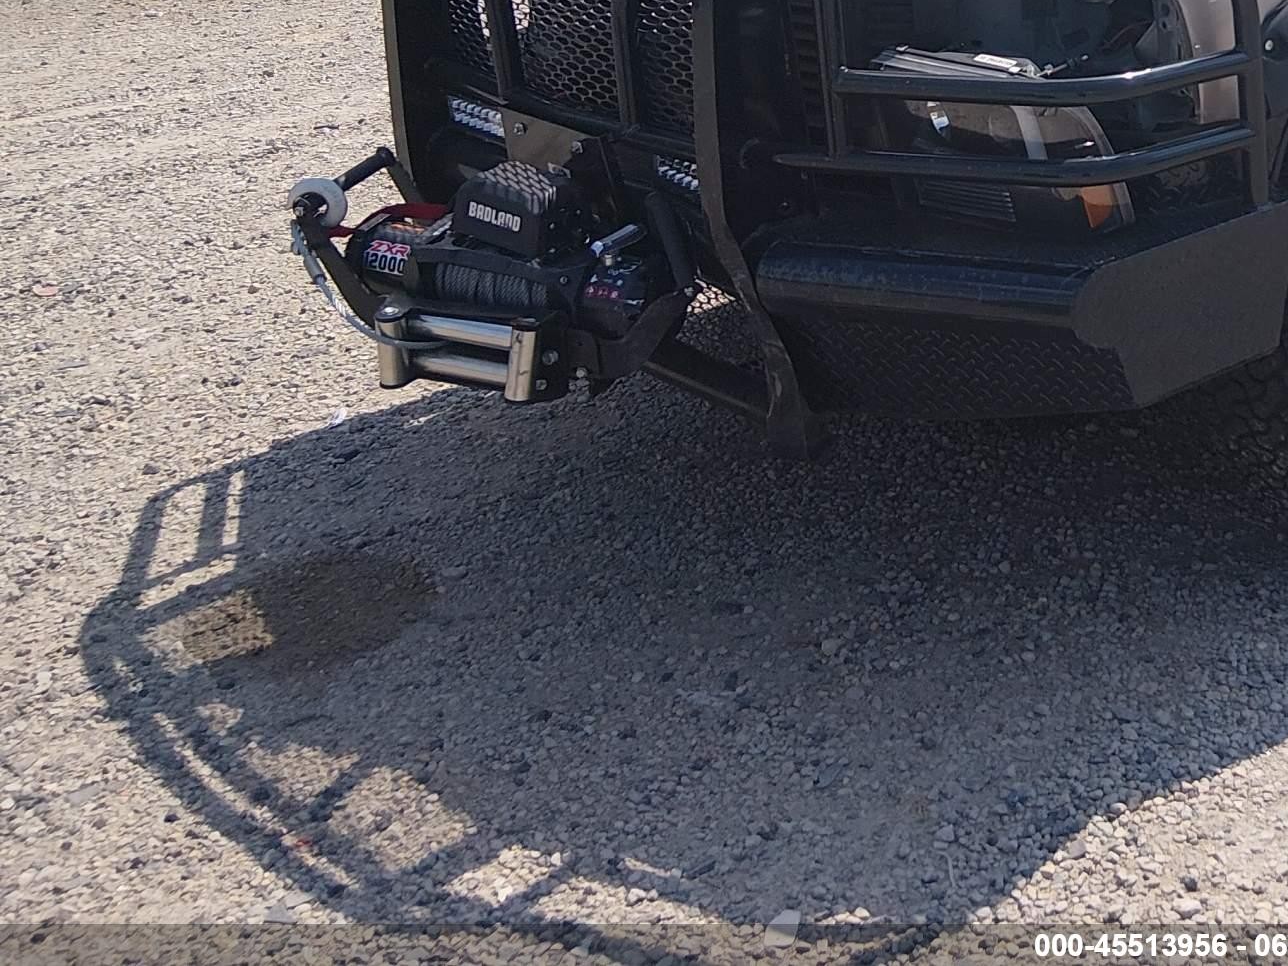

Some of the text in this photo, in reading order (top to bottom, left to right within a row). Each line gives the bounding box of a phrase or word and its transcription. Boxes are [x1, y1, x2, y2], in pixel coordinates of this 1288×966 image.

[467, 200, 522, 232] BADLAND
[363, 249, 407, 275] 12000
[367, 239, 411, 259] ZXR
